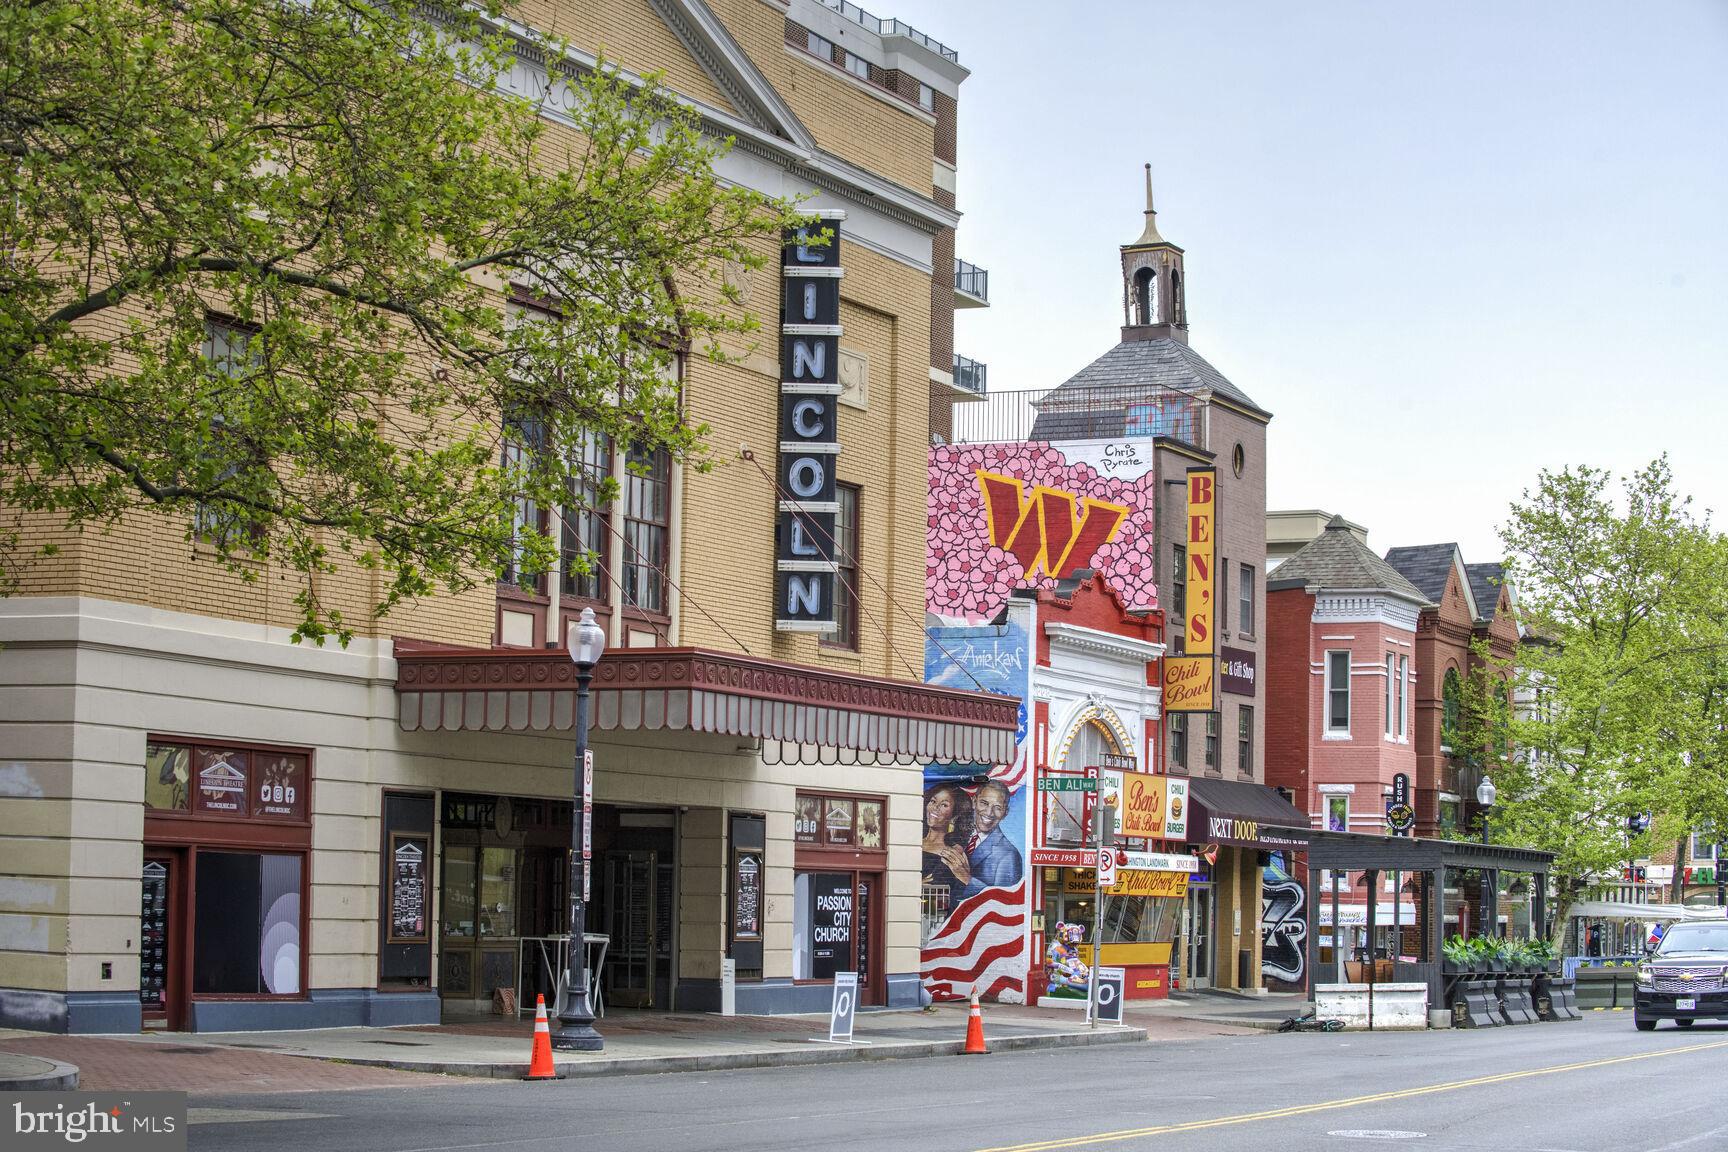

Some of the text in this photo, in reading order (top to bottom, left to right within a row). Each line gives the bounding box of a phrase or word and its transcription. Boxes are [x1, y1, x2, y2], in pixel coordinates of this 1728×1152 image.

[788, 226, 826, 614] LINCOLN
[1105, 444, 1136, 458] Chris
[1100, 458, 1143, 472] Pyrate
[1188, 476, 1212, 643] BEN'S
[1166, 660, 1200, 685] Chili
[1229, 661, 1234, 675] &
[1234, 661, 1242, 677] Gift
[1243, 663, 1254, 684] Shop
[1166, 675, 1212, 706] Bowl
[1038, 779, 1060, 790] BEN
[1065, 779, 1082, 790] ALI
[1104, 776, 1119, 788] CHILI
[1171, 784, 1184, 795] CHILI
[1128, 780, 1159, 813] Ben's
[1125, 812, 1141, 831] Chili
[1141, 814, 1163, 832] Bowl
[1167, 822, 1185, 833] BURGER
[1034, 853, 1077, 862] SINCE 1958
[1128, 856, 1169, 869] HINGTON LANDMARK
[1176, 860, 1188, 869] SINCE
[1684, 867, 1717, 884] 7-EL
[1068, 881, 1096, 890] SHAKE
[817, 895, 852, 911] PASSION
[833, 911, 852, 926] CITY
[814, 927, 849, 942] CHURCH
